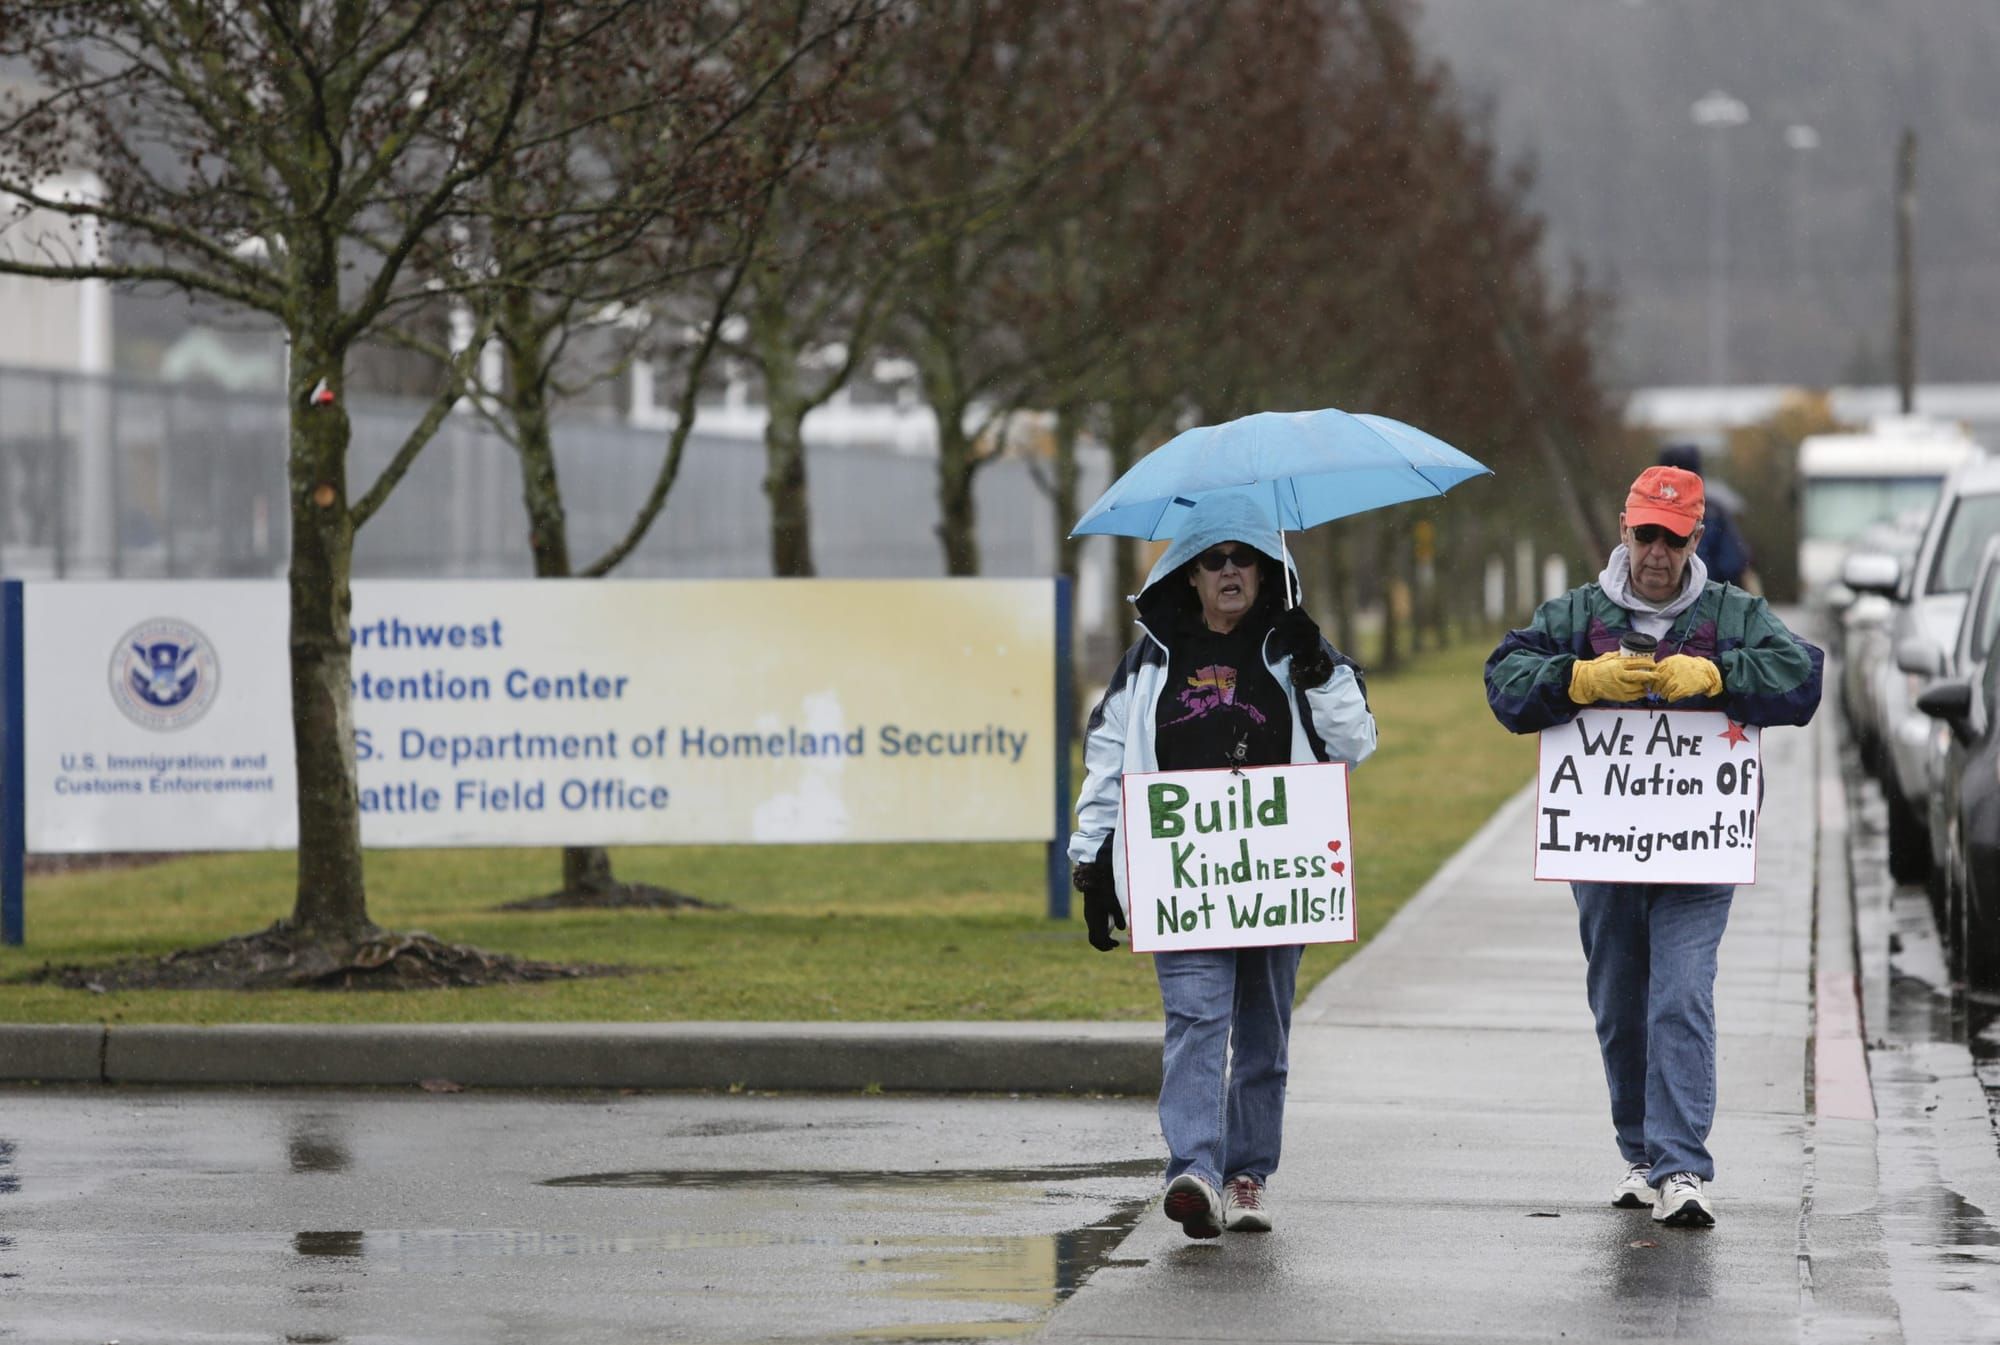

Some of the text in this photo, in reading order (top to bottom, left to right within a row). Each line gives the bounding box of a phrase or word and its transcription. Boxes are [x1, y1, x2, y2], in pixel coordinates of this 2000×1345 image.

[350, 618, 503, 647] rthwest
[351, 670, 628, 700] tention Center
[60, 753, 267, 774] U.S. Immigration and
[354, 725, 1027, 766] S. Department of Homeland Security
[54, 775, 274, 794] Customs Enforcement
[1549, 755, 1757, 796] A Nation Of
[359, 779, 669, 812] attle Field Office
[1148, 776, 1288, 839] Build
[1540, 807, 1755, 862] Immigrants!!
[1157, 887, 1346, 935] Not Walls!!
